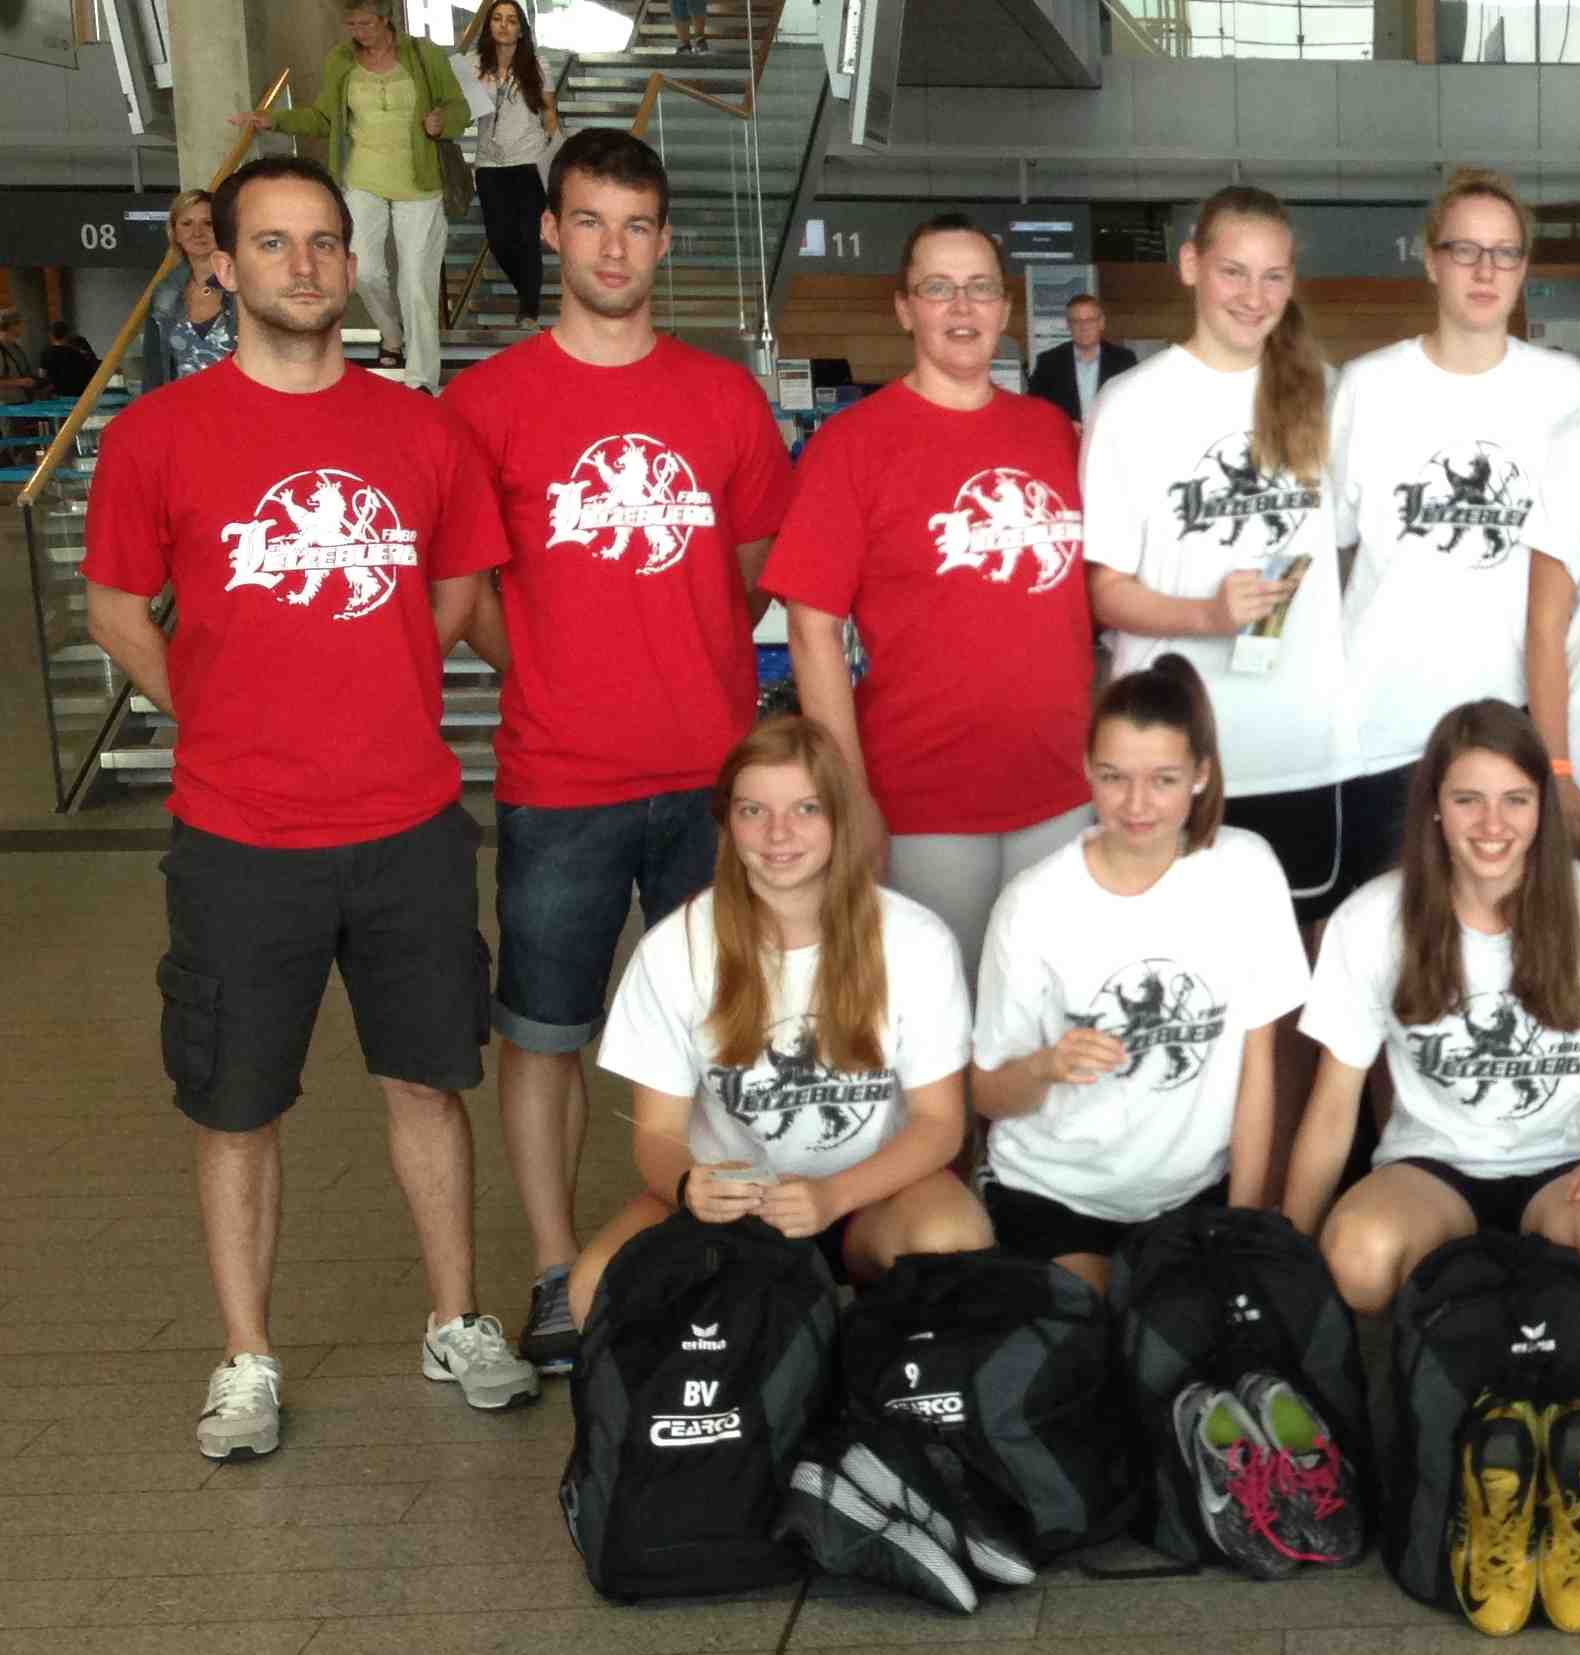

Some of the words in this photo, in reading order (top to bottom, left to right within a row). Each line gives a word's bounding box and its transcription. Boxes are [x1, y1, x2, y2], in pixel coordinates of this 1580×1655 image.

[80, 223, 118, 250] 08
[831, 231, 861, 257] 11
[904, 1362, 920, 1390] 9
[682, 1379, 720, 1408] BV
